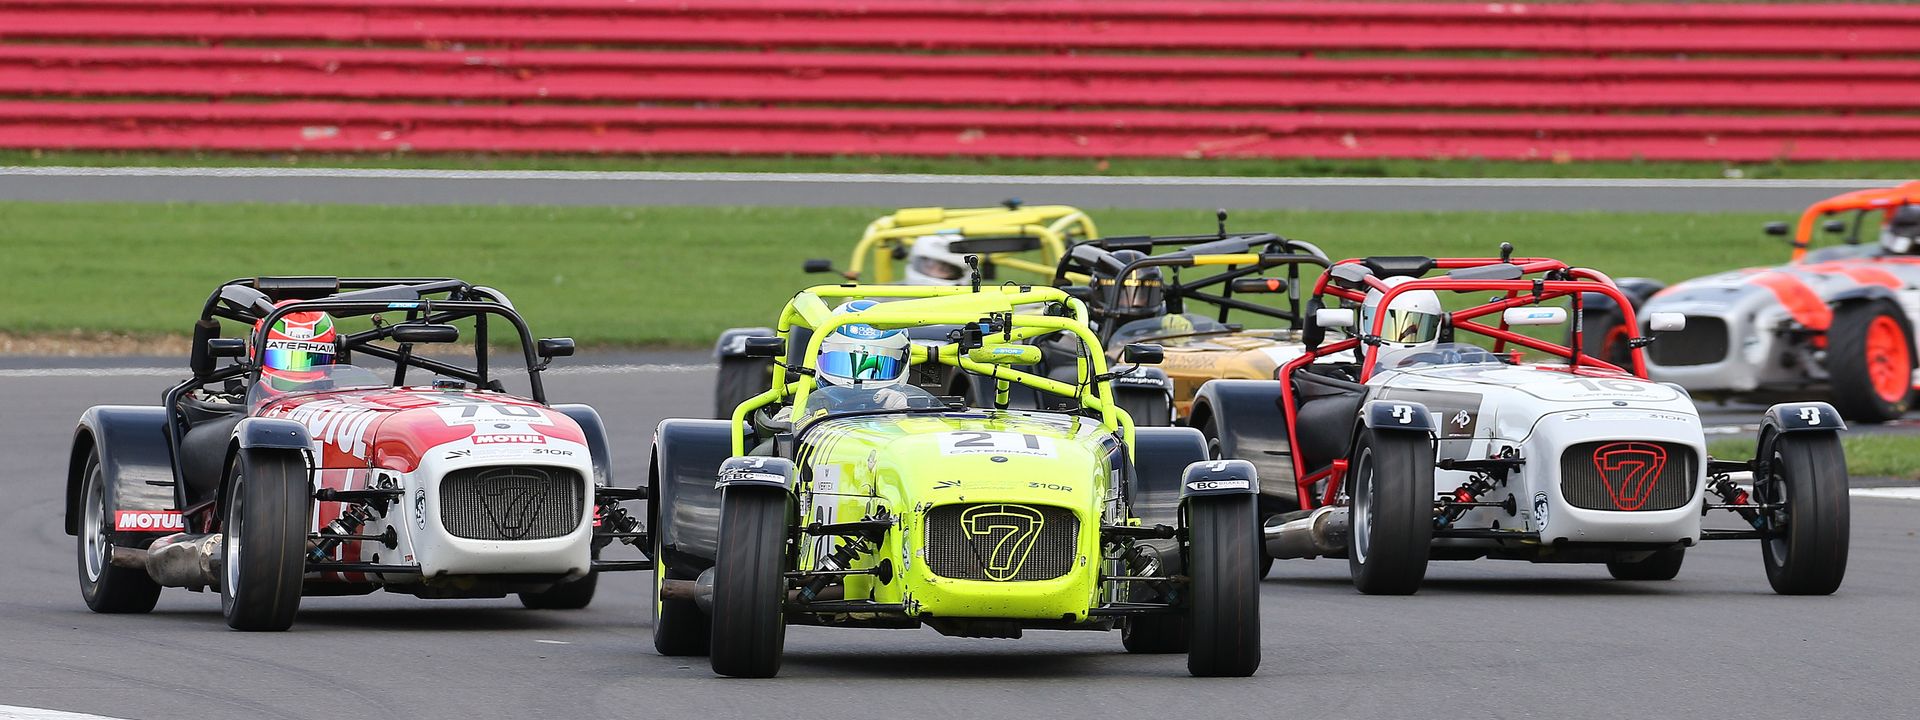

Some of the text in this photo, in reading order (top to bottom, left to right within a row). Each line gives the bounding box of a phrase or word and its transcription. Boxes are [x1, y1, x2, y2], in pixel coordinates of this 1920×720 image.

[266, 341, 335, 353] ATERHAM
[435, 404, 542, 418] 70
[1649, 413, 1687, 422] 310R
[476, 435, 545, 444] MOTUL
[951, 431, 1040, 450] 21
[532, 448, 573, 457] 310R
[1028, 482, 1073, 493] 310R
[119, 513, 185, 529] MOTUL
